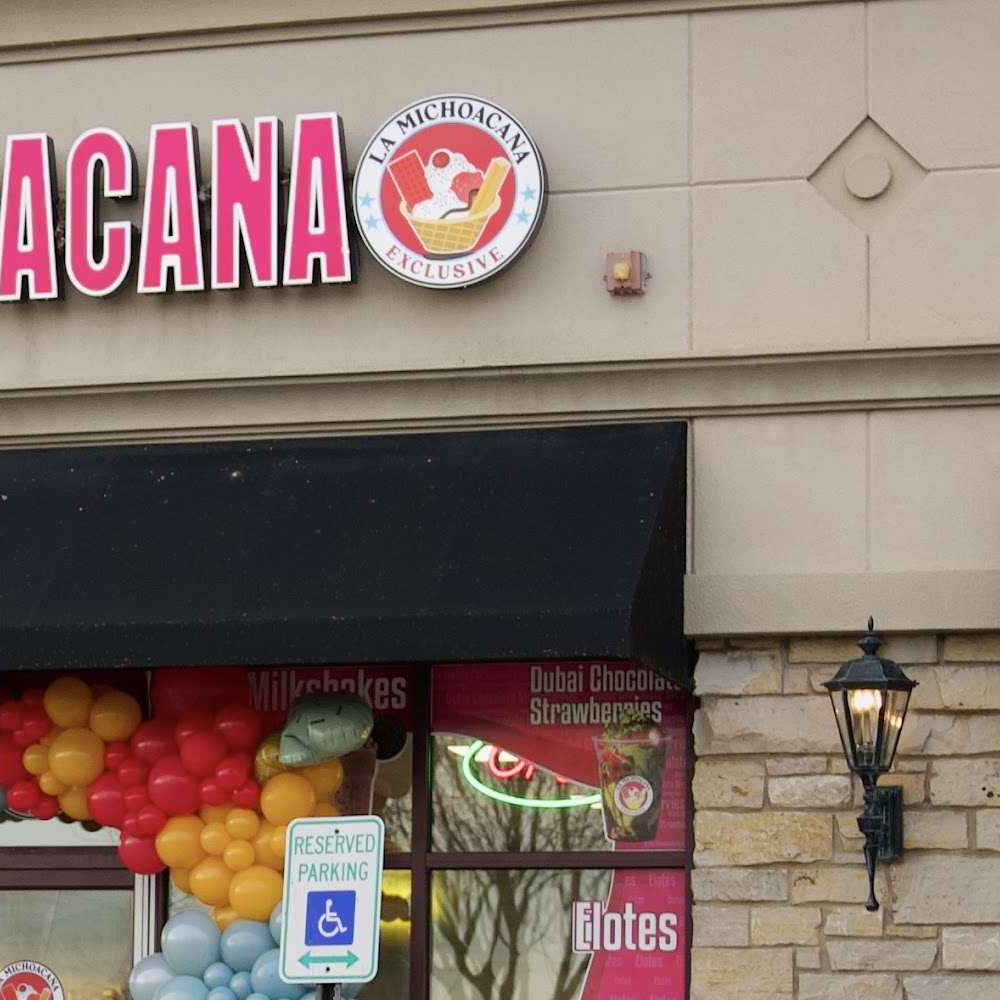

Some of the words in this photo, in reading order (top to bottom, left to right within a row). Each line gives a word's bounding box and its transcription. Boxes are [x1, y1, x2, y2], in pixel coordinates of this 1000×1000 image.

[368, 137, 397, 165] LA
[396, 101, 531, 166] MICHOACANA
[385, 244, 504, 280] EXCLUSIVE
[530, 665, 584, 693] Dubai
[294, 833, 376, 855] RESERVED
[298, 861, 369, 883] PARKING
[576, 902, 678, 951] Elotes
[3, 962, 59, 992] MICHOACANA
